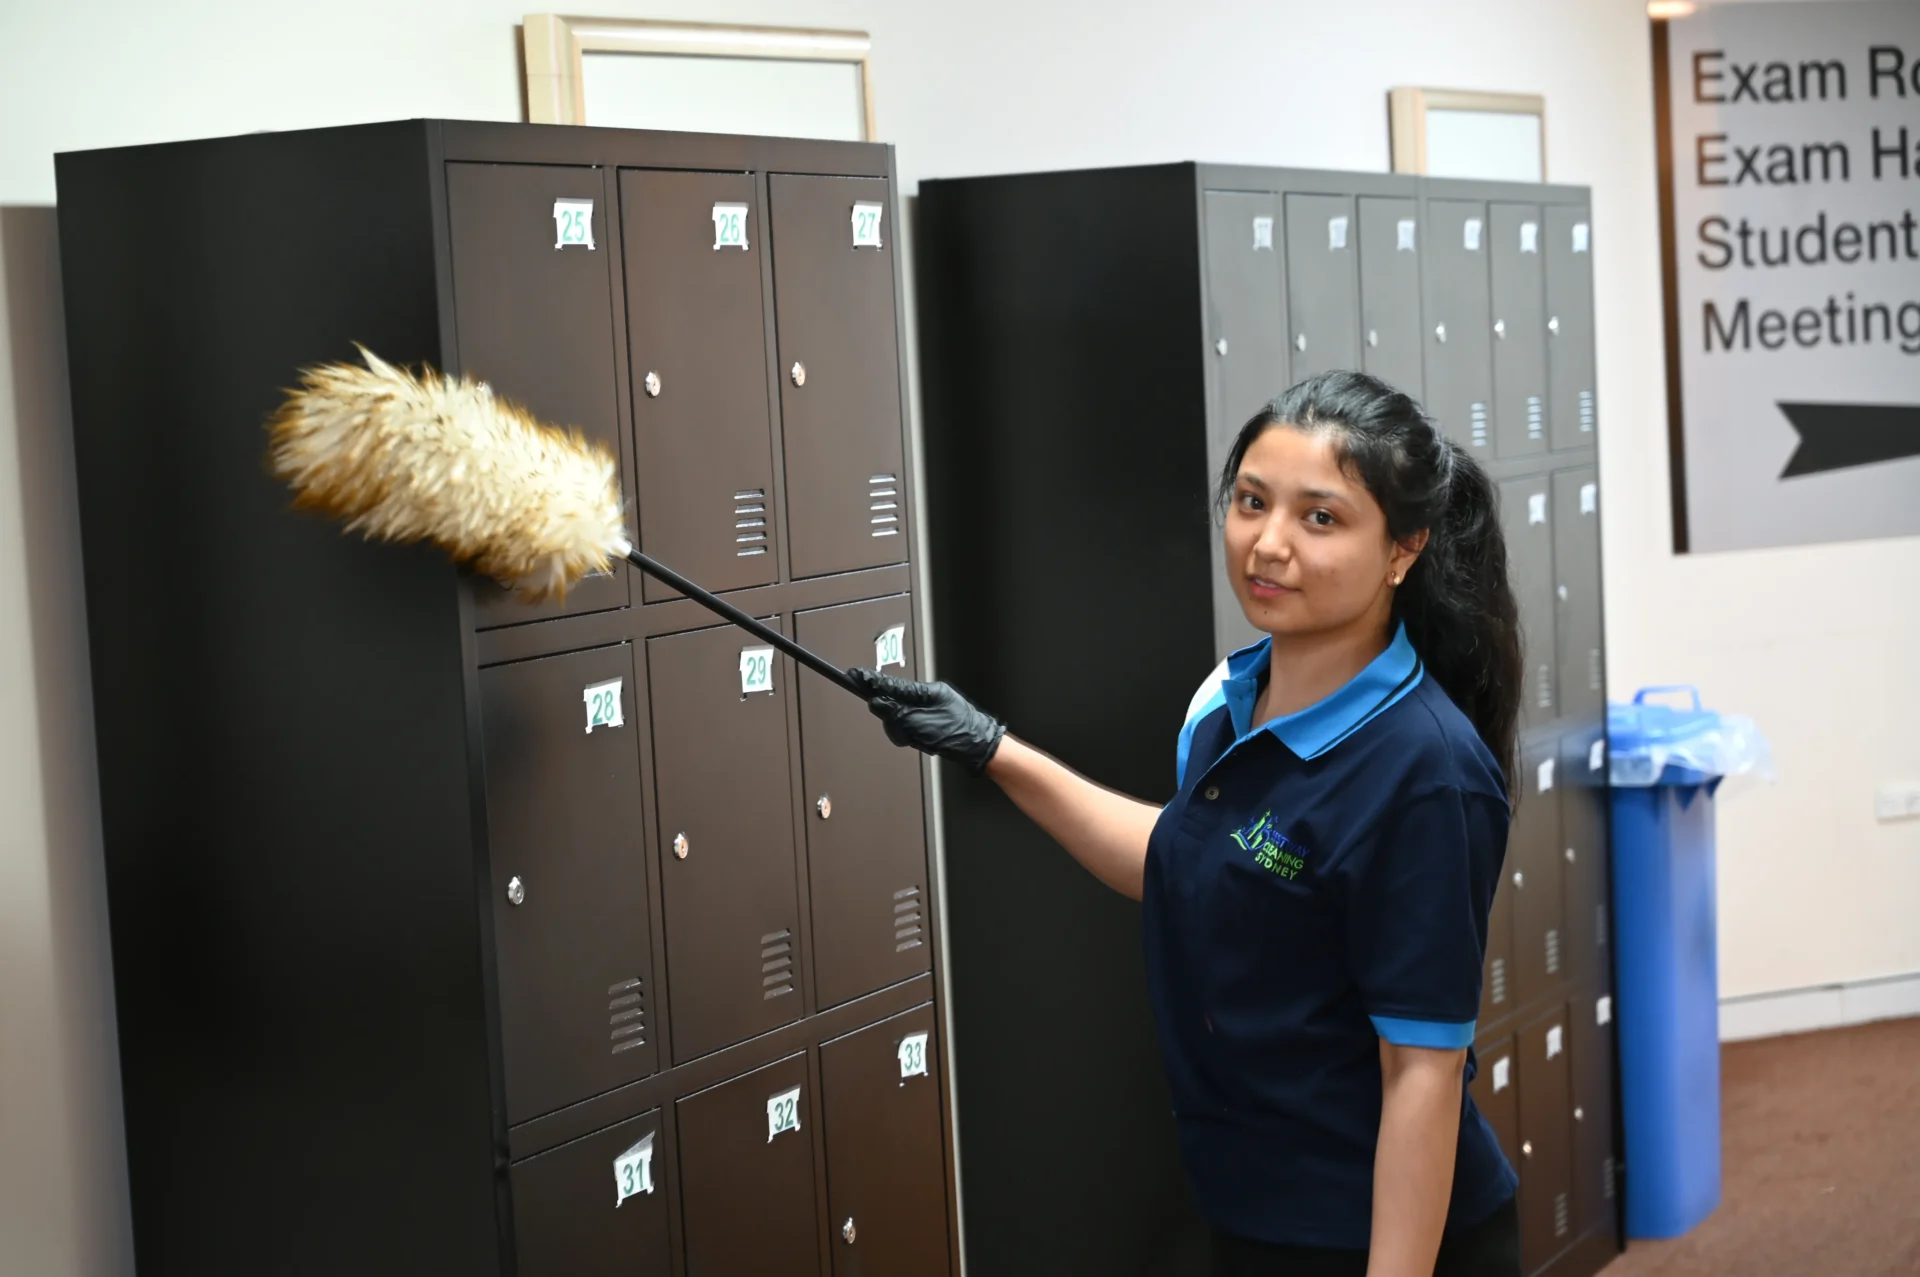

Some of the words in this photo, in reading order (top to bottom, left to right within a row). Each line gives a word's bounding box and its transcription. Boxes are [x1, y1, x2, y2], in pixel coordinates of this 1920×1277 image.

[1693, 50, 1846, 103] Exam
[1696, 133, 1850, 186] Exam
[1872, 126, 1920, 179] H
[561, 210, 585, 242] 25
[719, 212, 740, 243] 26
[857, 211, 876, 239] 27
[1697, 209, 1919, 269] Student
[1702, 291, 1920, 355] Meeting
[881, 633, 898, 663] 30
[745, 655, 766, 686] 29
[591, 689, 613, 724] 28
[1254, 852, 1298, 880] SYDNEY
[1262, 841, 1304, 869] CLEANING
[904, 1041, 921, 1070] 33
[774, 1098, 794, 1131] 32
[623, 1159, 643, 1194] 31
